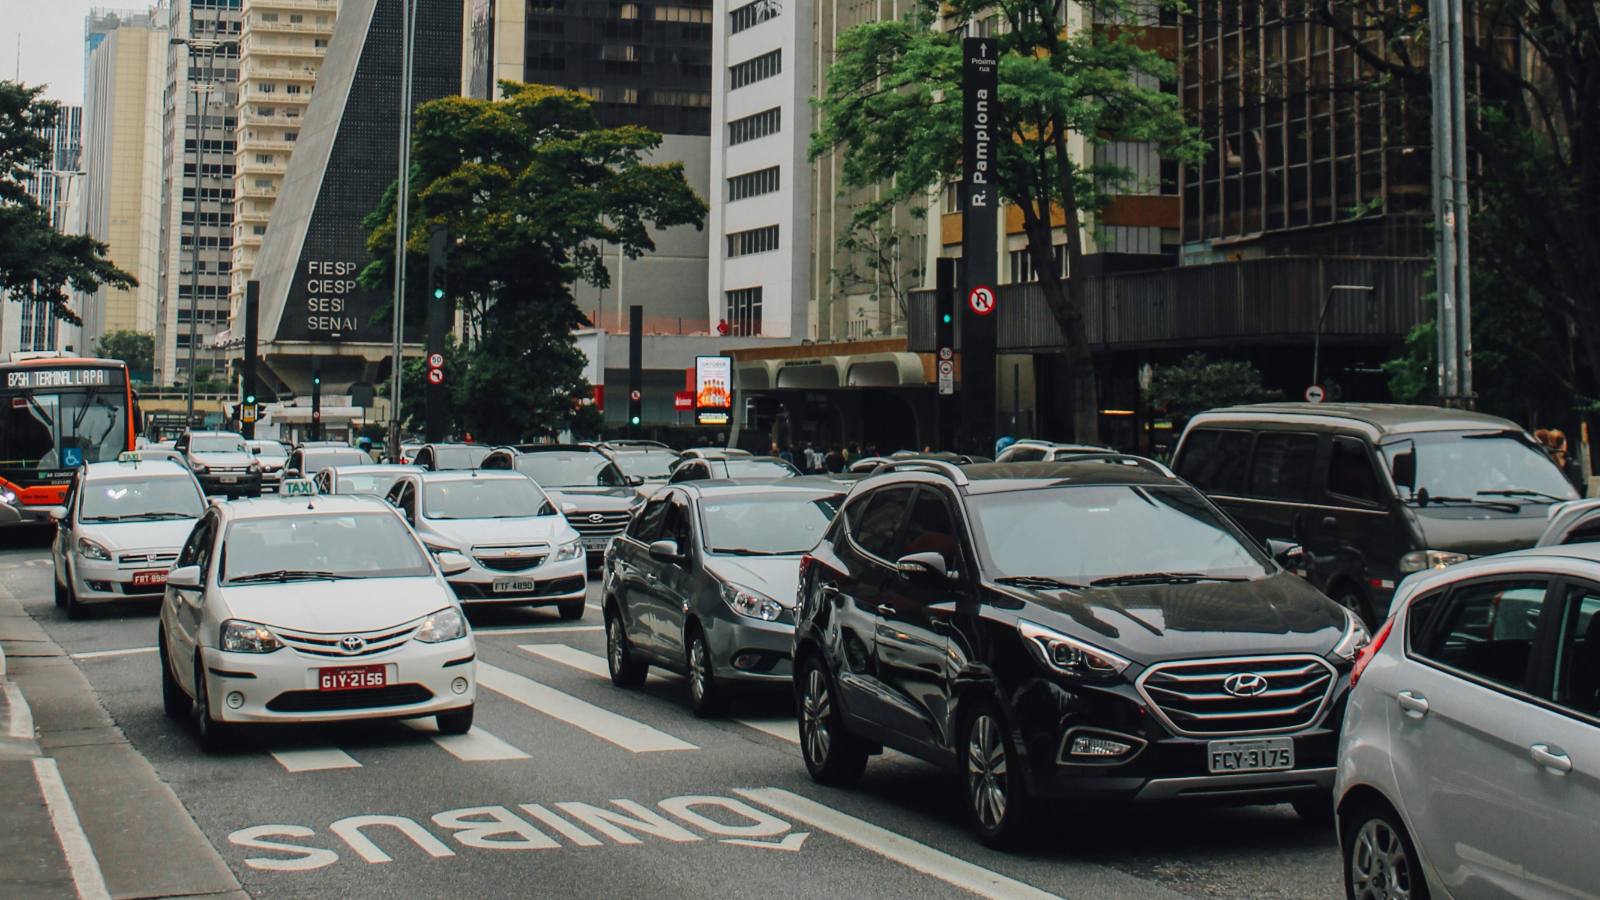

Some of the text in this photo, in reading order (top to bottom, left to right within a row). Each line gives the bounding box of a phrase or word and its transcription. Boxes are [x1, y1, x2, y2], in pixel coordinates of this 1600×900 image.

[972, 88, 990, 206] R. Pamplona
[308, 261, 357, 275] FIESP
[307, 279, 356, 294] CIESP
[308, 298, 345, 312] SESI
[307, 316, 357, 331] SENAI
[35, 370, 73, 386] TERMINAL
[76, 369, 104, 384] LAPA
[285, 482, 312, 493] TAXI
